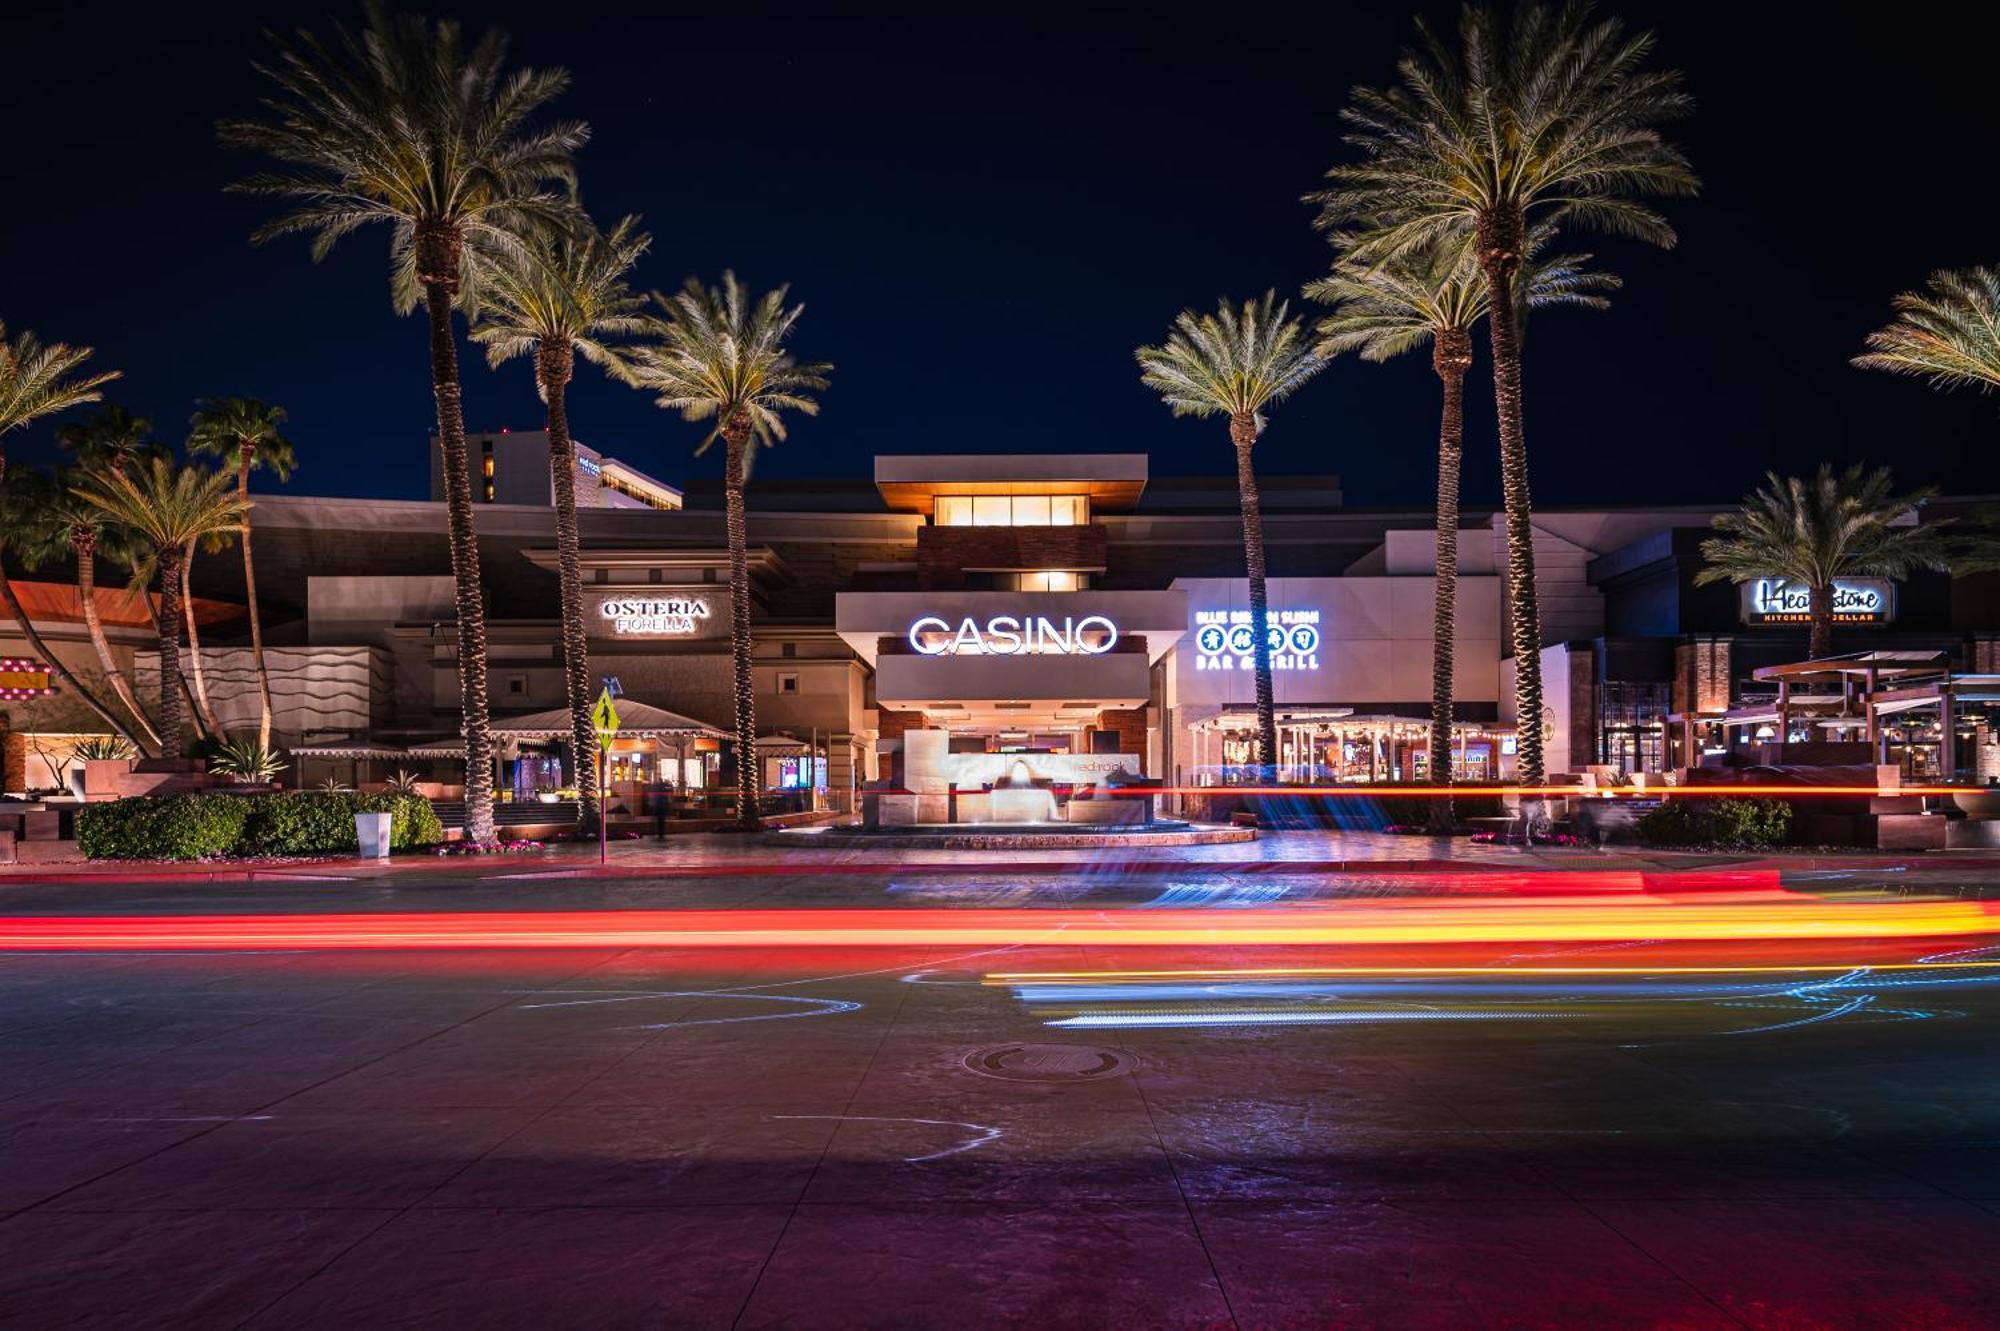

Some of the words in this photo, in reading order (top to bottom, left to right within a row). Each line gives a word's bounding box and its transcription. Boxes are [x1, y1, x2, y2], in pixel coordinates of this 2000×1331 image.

[1760, 581, 1880, 610] Heastone
[603, 601, 705, 616] OSTERIA
[617, 619, 692, 631] FIORELLA
[908, 616, 1118, 655] CASINO
[1195, 655, 1234, 670] BAR
